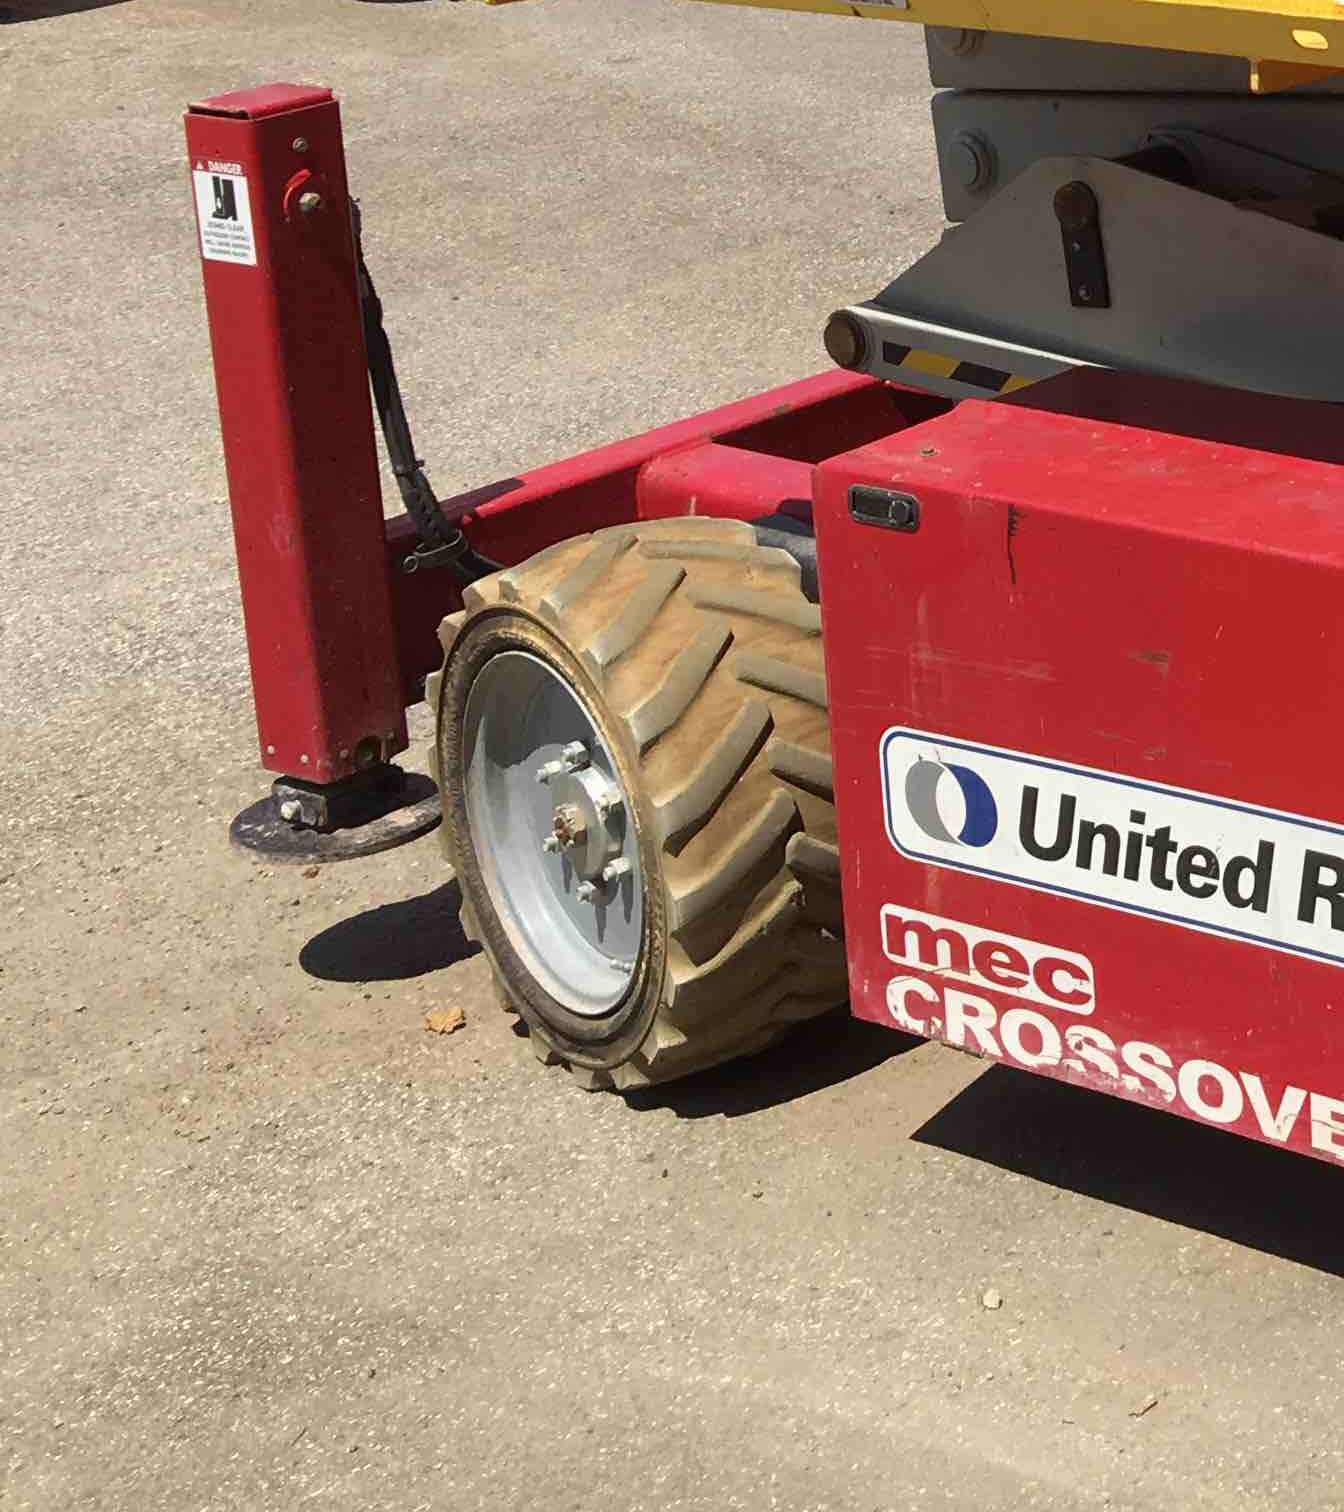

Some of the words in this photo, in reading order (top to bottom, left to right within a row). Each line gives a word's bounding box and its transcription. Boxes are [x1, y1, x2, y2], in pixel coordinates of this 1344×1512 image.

[207, 160, 243, 176] DANGER
[1018, 785, 1276, 915] United
[884, 910, 1094, 1011] mec
